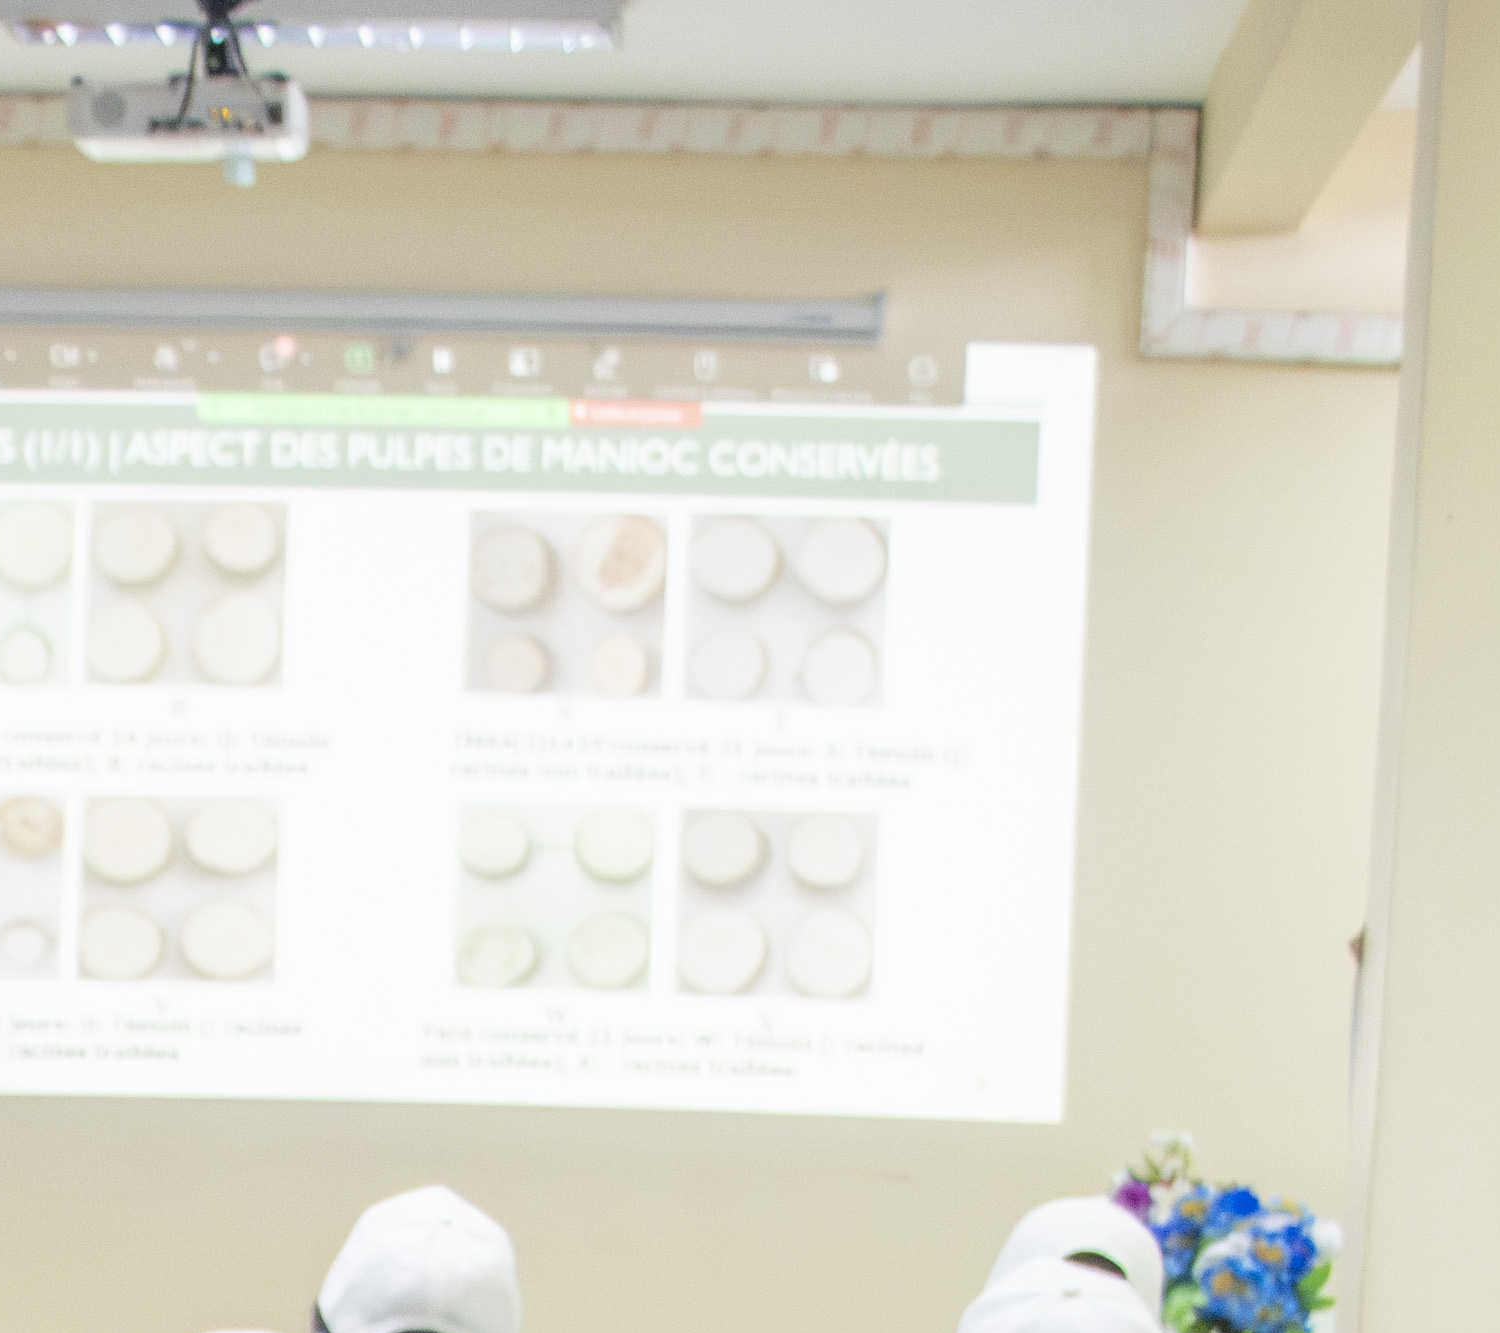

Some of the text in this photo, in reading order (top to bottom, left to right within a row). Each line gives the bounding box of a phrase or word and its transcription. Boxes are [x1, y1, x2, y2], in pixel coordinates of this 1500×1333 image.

[122, 428, 262, 468] ASPECT
[269, 430, 338, 469] DES
[347, 430, 471, 472] PULPES
[482, 433, 531, 472] DE
[541, 433, 699, 475] MANIOC
[707, 436, 941, 482] CONSERVÉES
